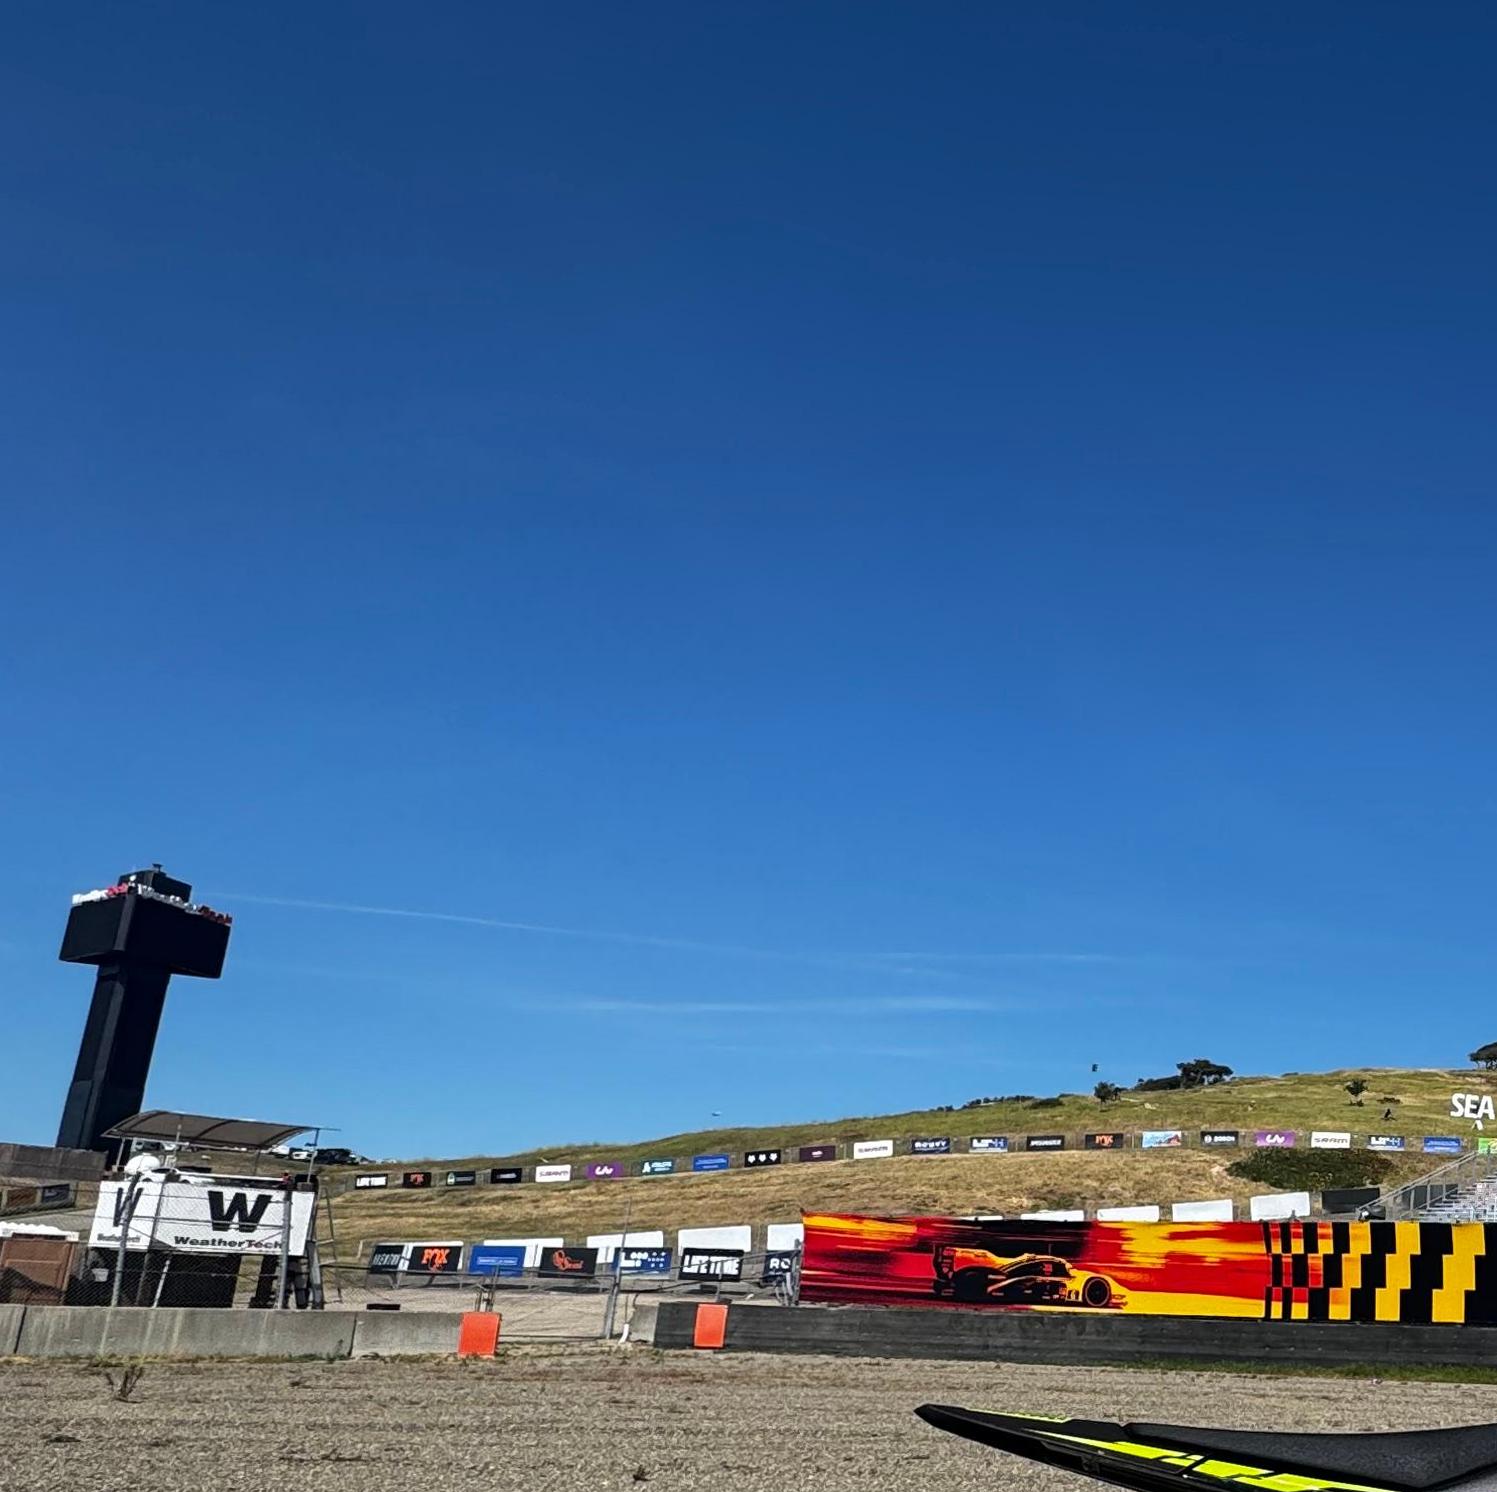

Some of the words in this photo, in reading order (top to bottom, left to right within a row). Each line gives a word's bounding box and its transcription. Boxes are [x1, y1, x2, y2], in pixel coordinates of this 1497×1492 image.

[1450, 1092, 1495, 1121] SEA
[207, 1190, 273, 1233] W
[173, 1235, 284, 1250] WeatherTech
[682, 1254, 709, 1274] LIFE
